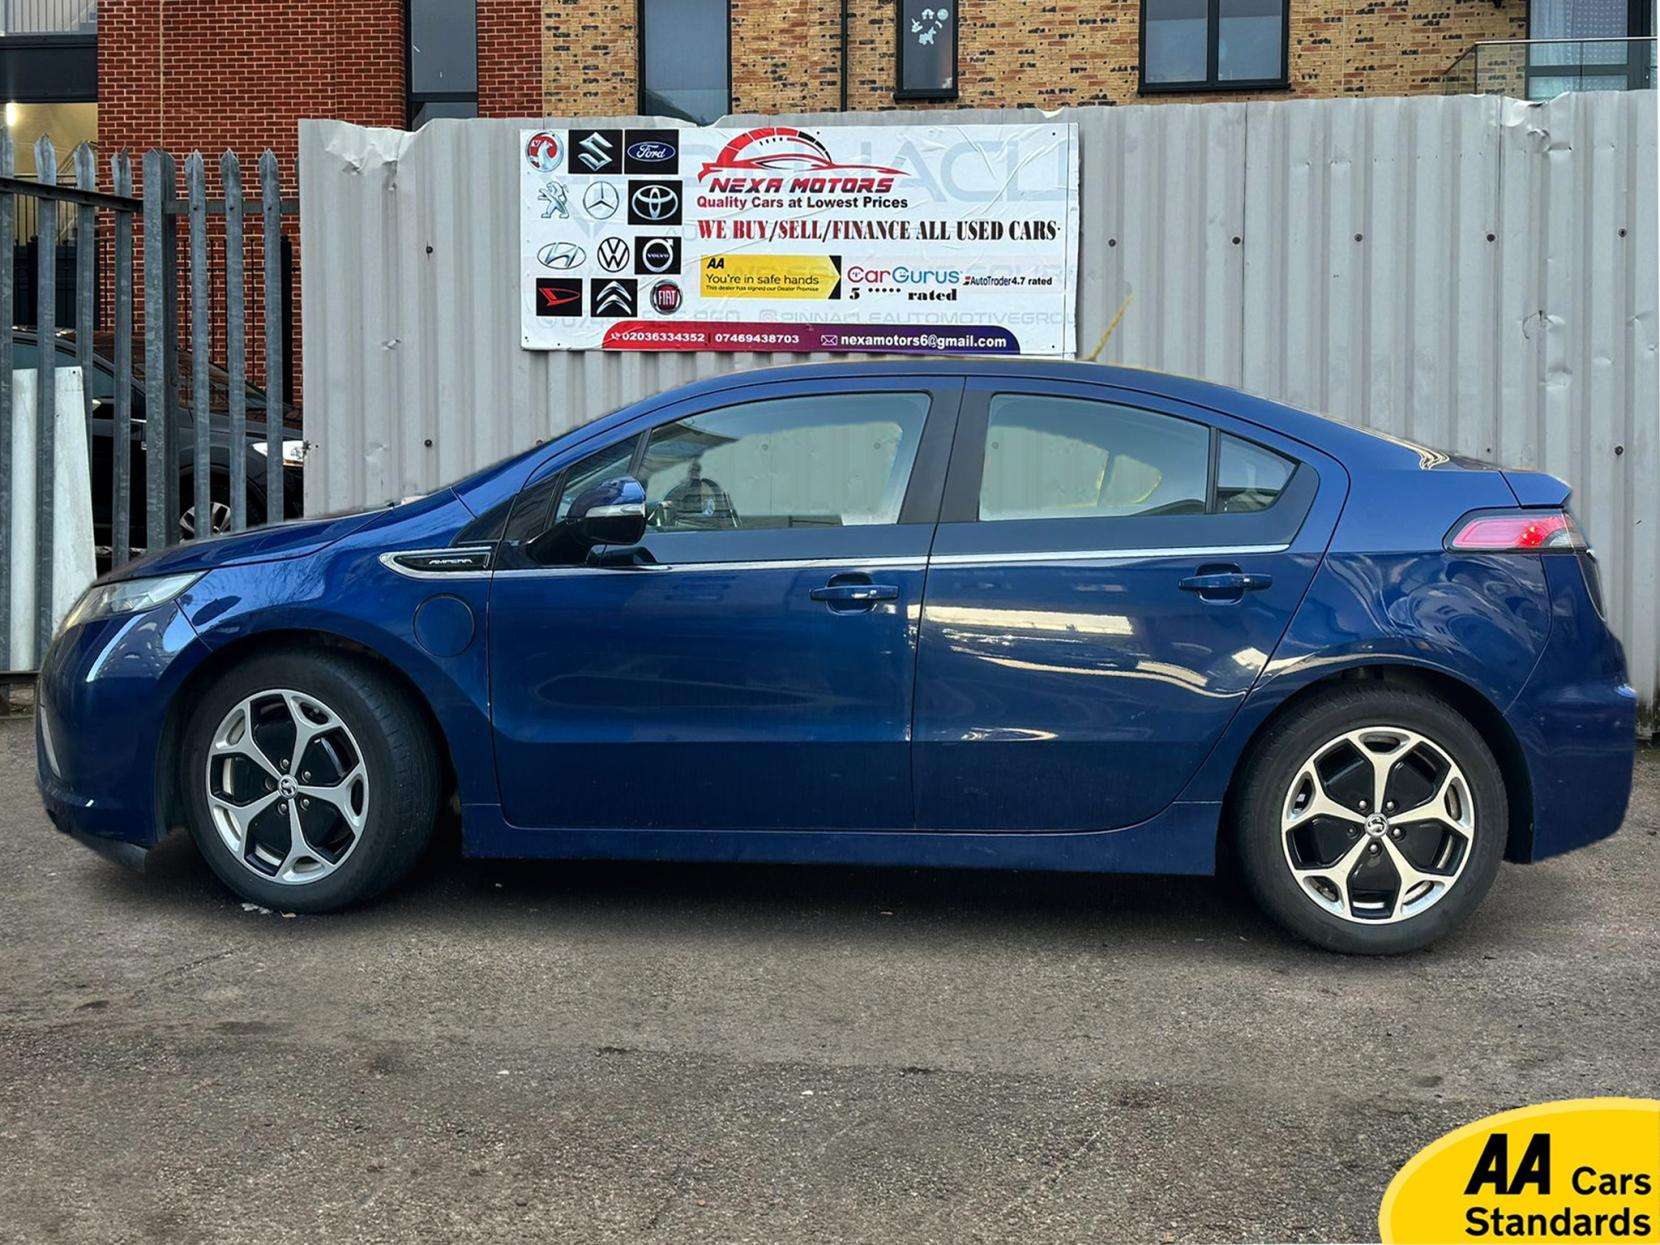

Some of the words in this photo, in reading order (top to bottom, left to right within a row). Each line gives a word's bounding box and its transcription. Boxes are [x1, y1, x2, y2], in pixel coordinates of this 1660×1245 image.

[636, 144, 665, 158] Ford
[709, 178, 784, 193] NEXA
[789, 177, 894, 193] MOTORS
[697, 196, 746, 209] Quality
[752, 196, 783, 208] Cars
[788, 197, 802, 208] at
[807, 196, 858, 208] Lowest
[863, 196, 908, 208] Prices
[698, 220, 726, 240] WE
[916, 221, 950, 240] ALL
[957, 221, 1004, 240] USED
[1009, 220, 1057, 240] CARS
[706, 257, 725, 269] AA
[706, 274, 741, 284] You're
[744, 274, 754, 284] in
[757, 273, 781, 284] safe
[784, 274, 819, 285] hands
[847, 266, 960, 284] CarGurus
[1028, 276, 1052, 286] rated
[658, 289, 676, 306] FIAT
[849, 287, 861, 300] 5
[908, 288, 957, 301] rated
[622, 333, 704, 342] 02036334352
[715, 334, 800, 344] 07469438703
[840, 334, 1007, 349] nexamotors6@gmail.com
